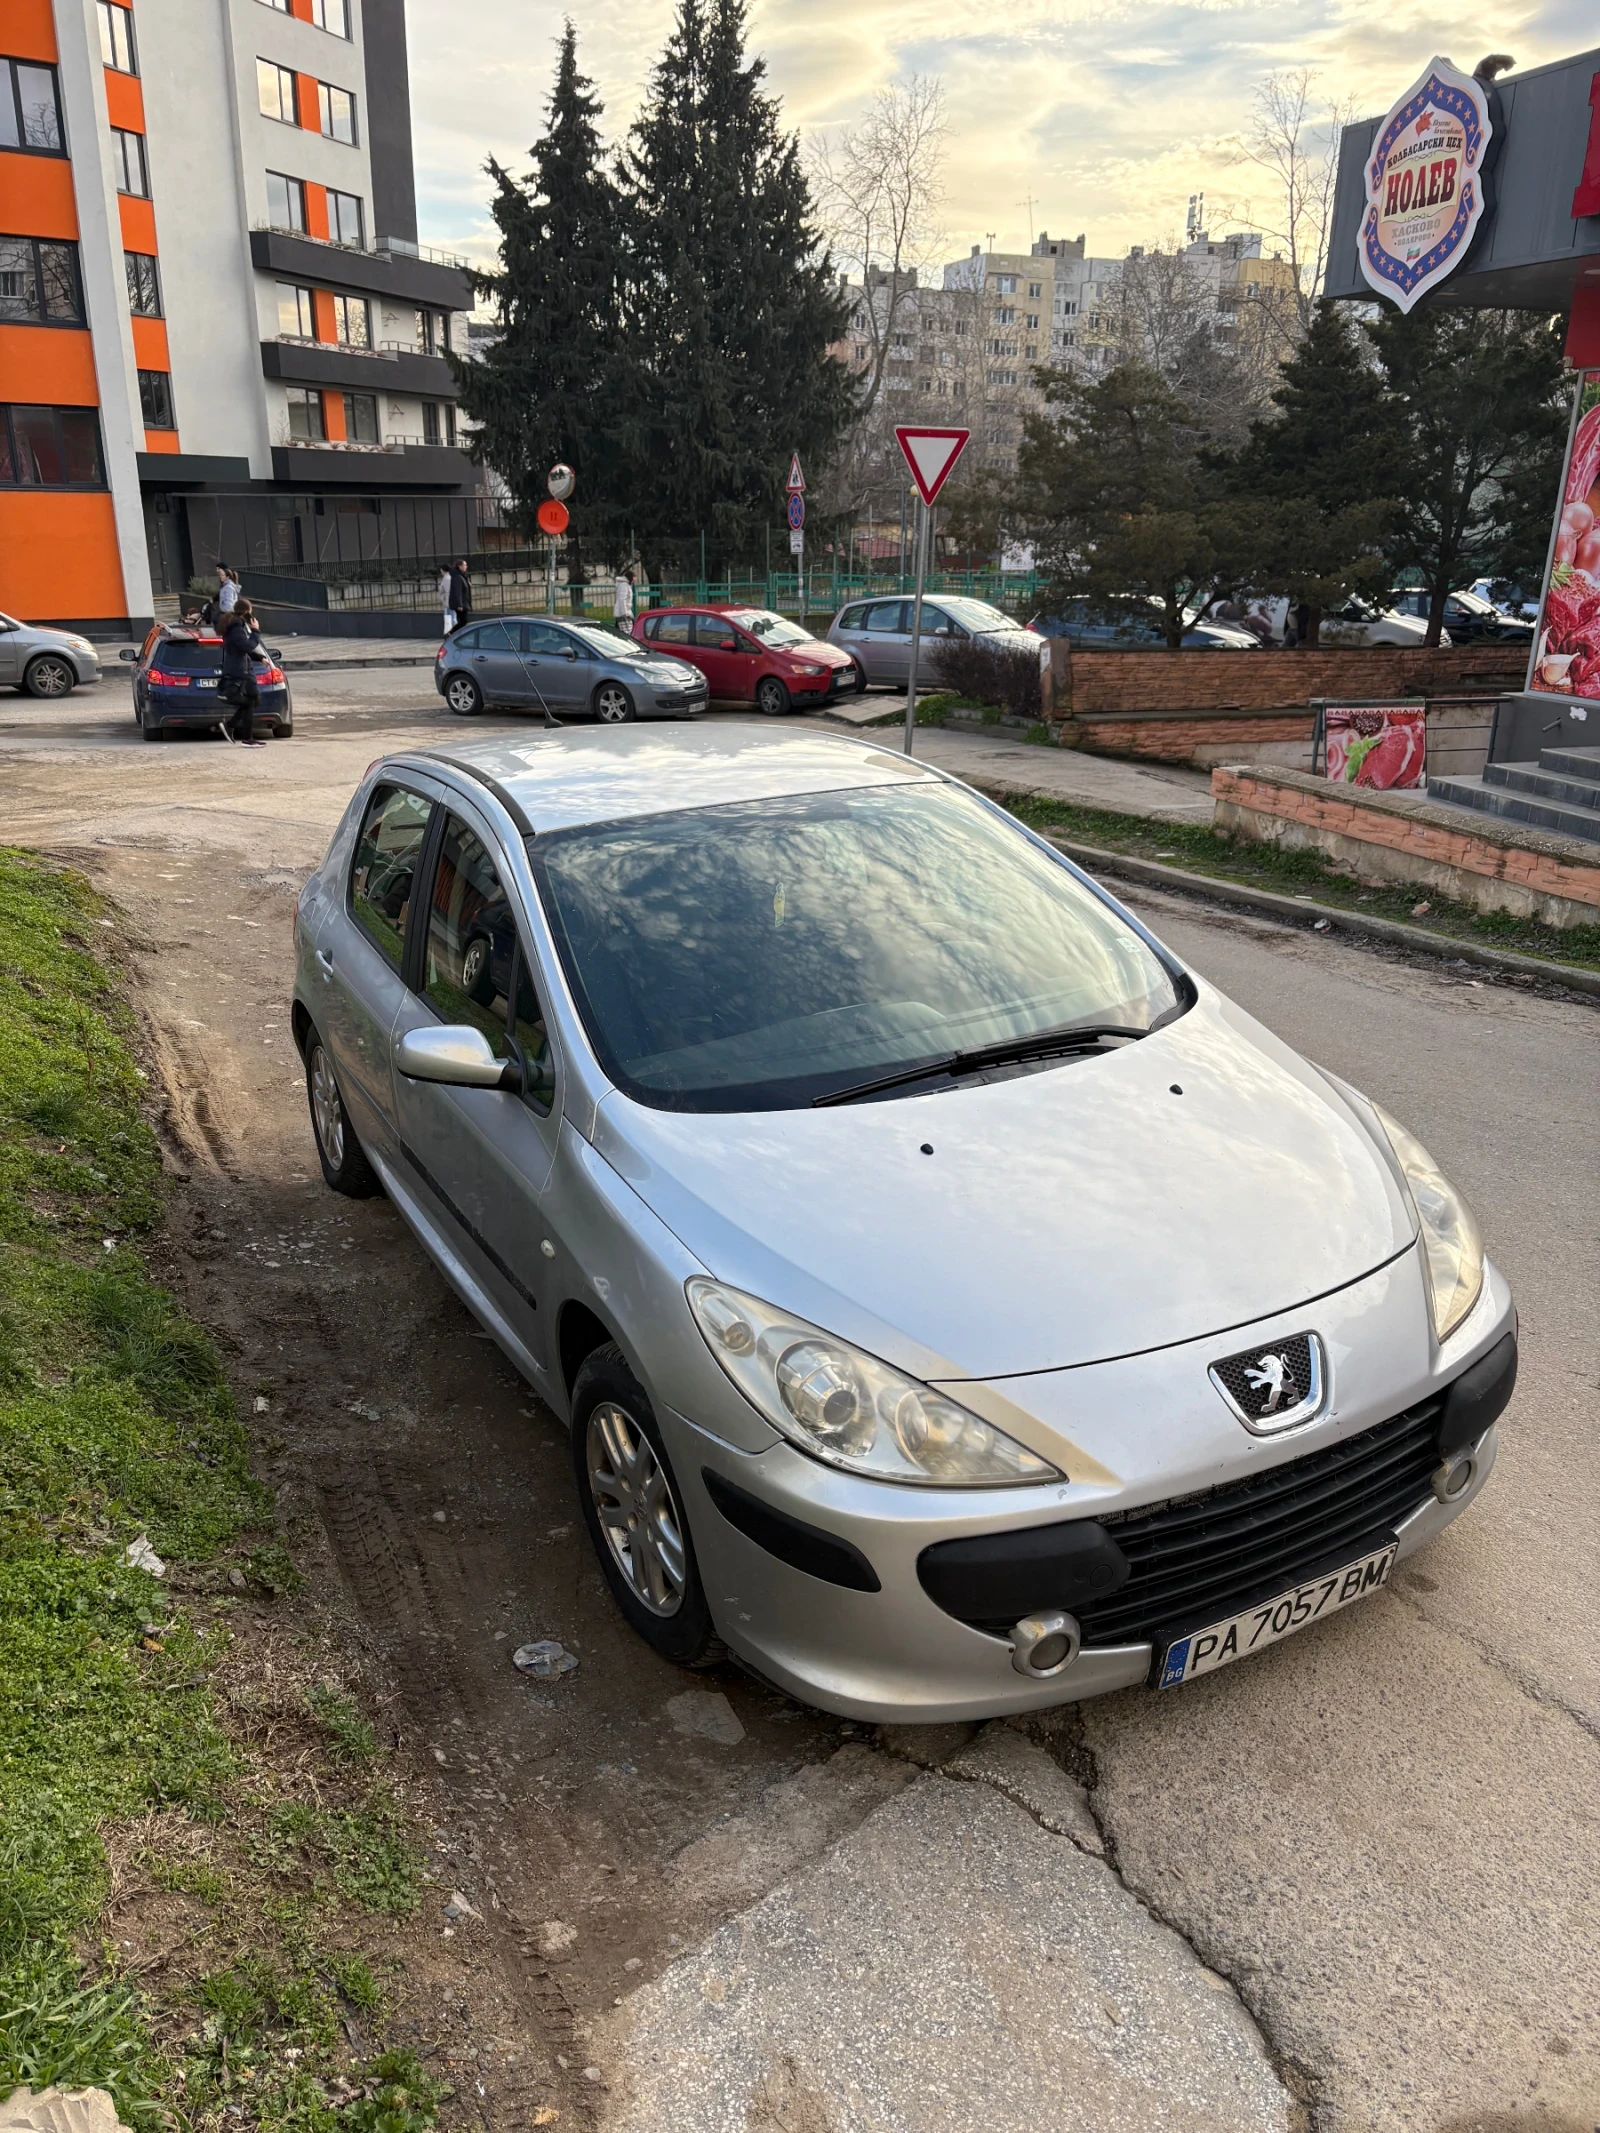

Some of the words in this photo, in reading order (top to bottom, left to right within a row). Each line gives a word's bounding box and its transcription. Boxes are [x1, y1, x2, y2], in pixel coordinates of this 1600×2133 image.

[1387, 137, 1445, 169] КОЛБАСАРСКИ
[1446, 136, 1463, 149] ЦЕХ
[1391, 219, 1441, 239] ХАСКОВО
[1191, 1624, 1237, 1671] PA
[1247, 1578, 1338, 1647] 7057
[1339, 1556, 1388, 1602] BM
[1166, 1667, 1183, 1682] BG
